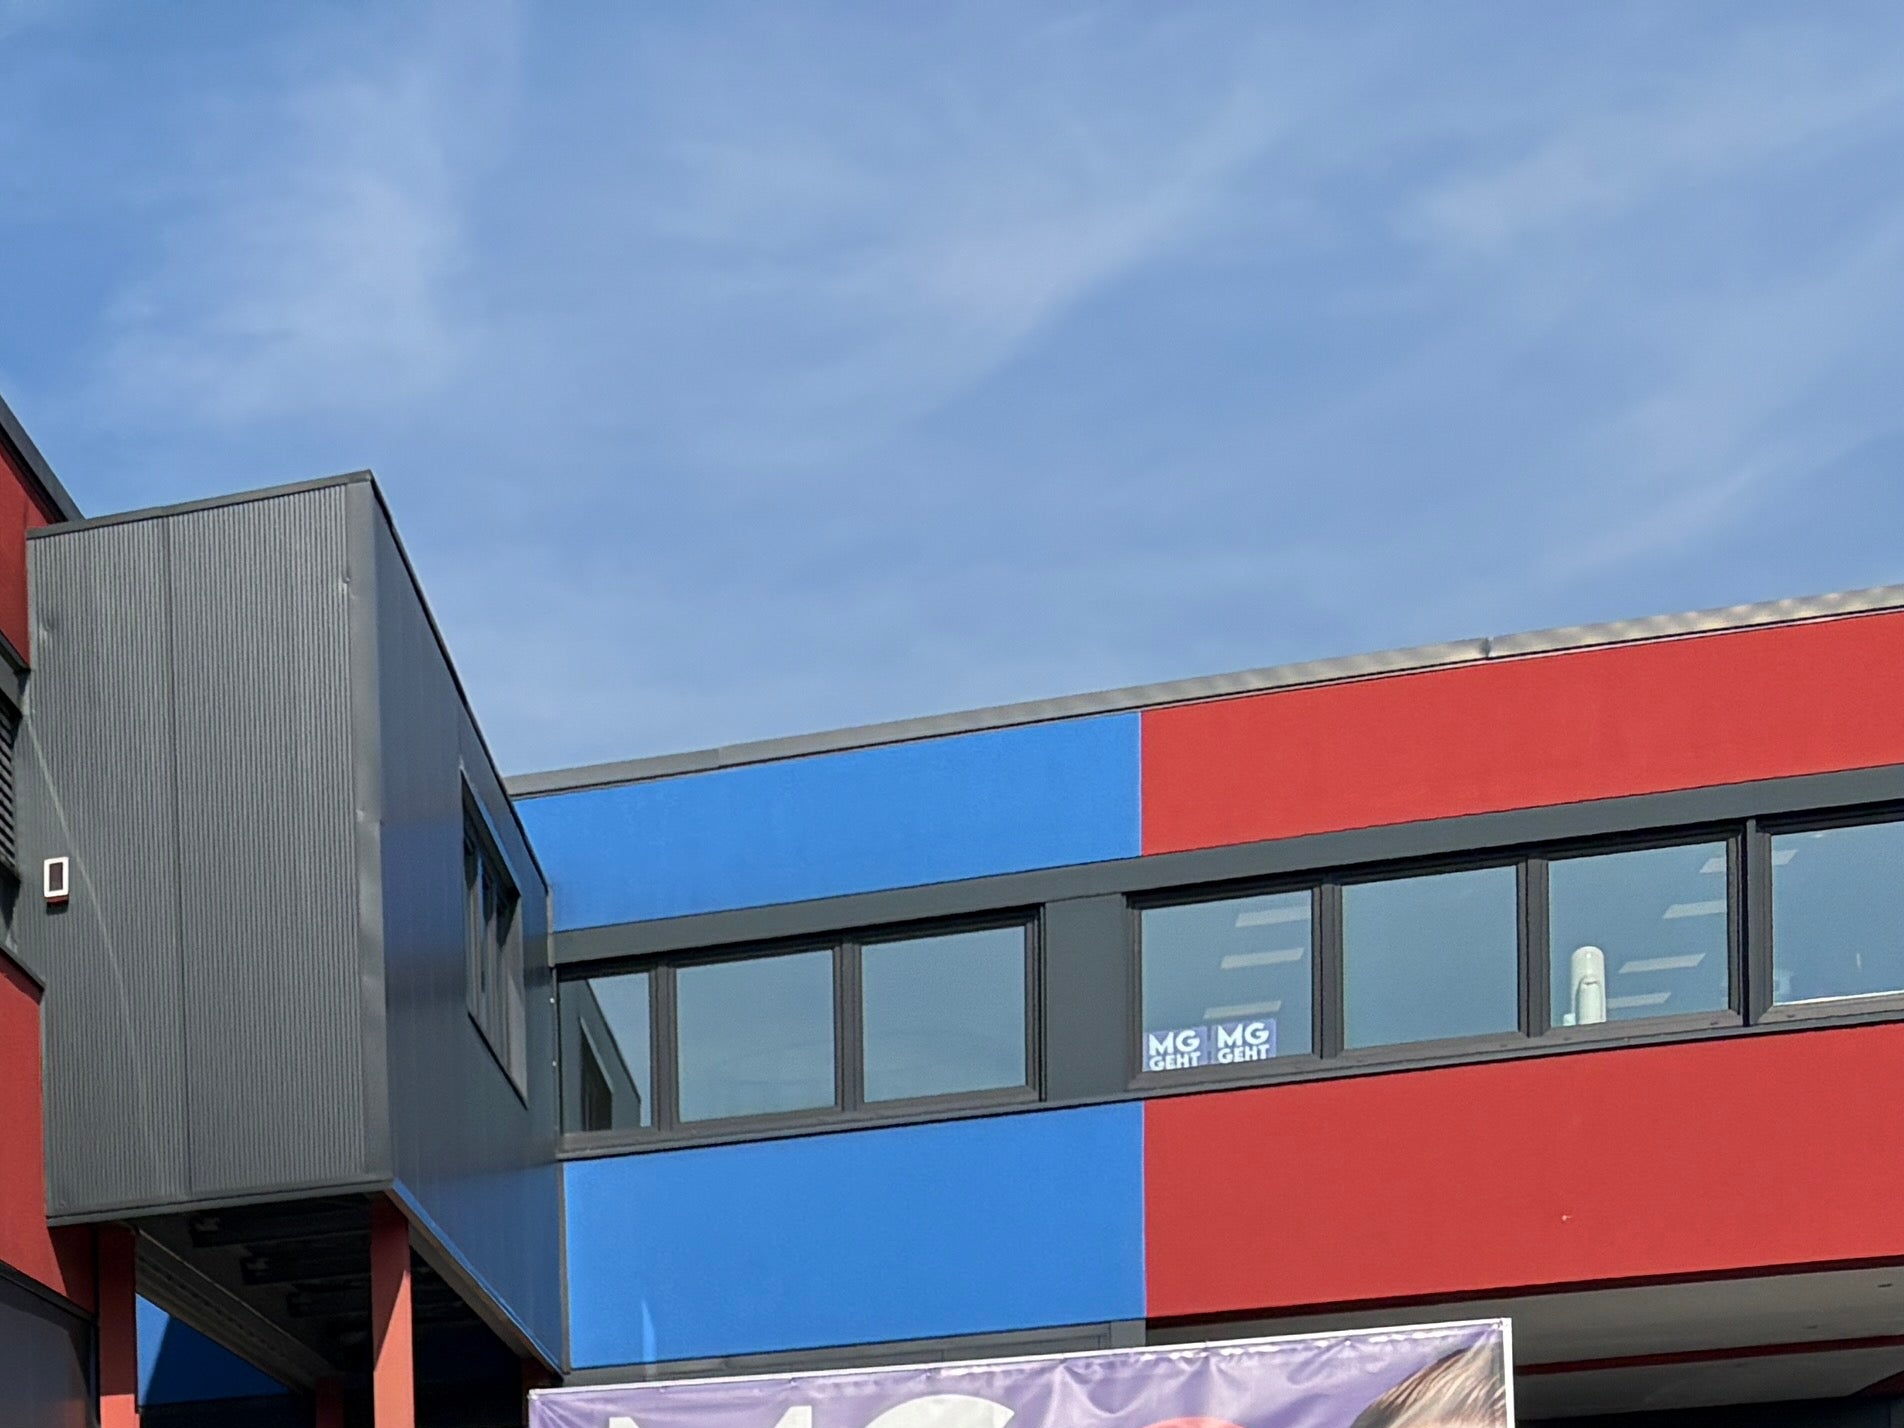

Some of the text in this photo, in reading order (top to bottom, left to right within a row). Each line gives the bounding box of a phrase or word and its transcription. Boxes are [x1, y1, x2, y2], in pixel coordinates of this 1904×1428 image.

[1149, 1029, 1200, 1056] MG
[1217, 1022, 1270, 1048] MG
[1149, 1051, 1201, 1071] GEHT
[1217, 1044, 1270, 1064] GEHT
